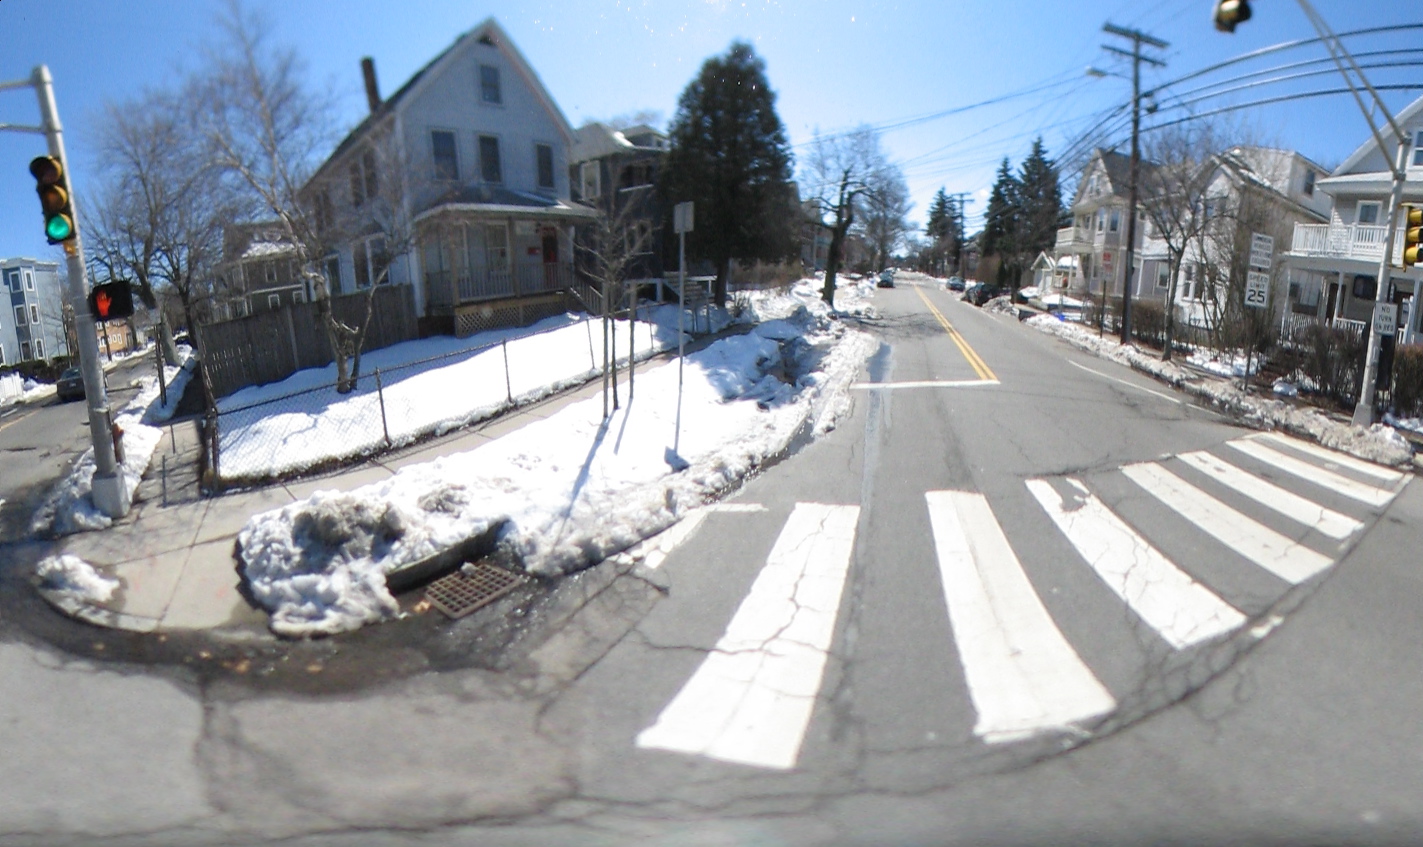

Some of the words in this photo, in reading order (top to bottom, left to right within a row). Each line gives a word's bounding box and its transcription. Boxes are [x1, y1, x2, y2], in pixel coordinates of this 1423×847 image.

[1249, 274, 1268, 283] SPEED
[1250, 281, 1265, 289] LIMIT
[1247, 289, 1265, 303] 25
[1382, 305, 1391, 314] NO
[1379, 313, 1392, 322] TURN
[1383, 323, 1394, 332] RED
